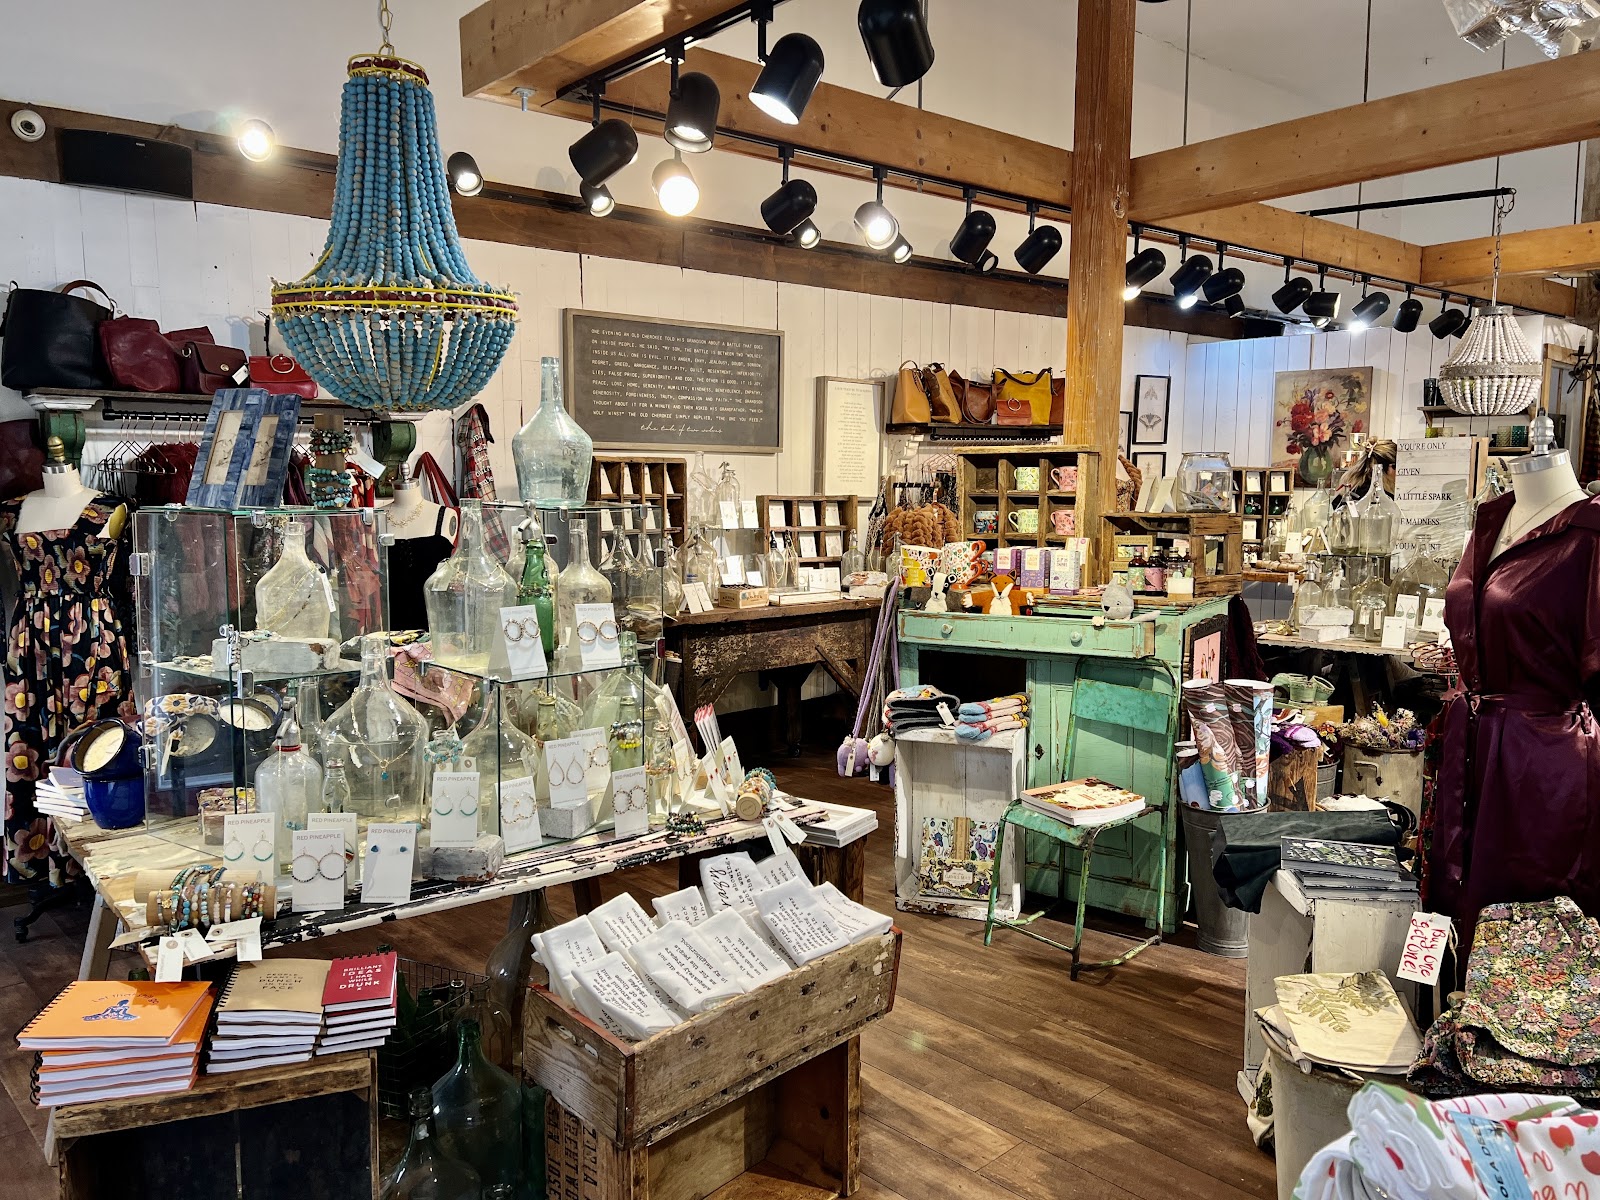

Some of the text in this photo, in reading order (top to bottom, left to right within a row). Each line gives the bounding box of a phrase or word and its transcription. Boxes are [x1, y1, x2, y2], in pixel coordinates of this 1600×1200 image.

[725, 857, 738, 892] showing.
[734, 868, 744, 886] want
[744, 874, 753, 892] that
[710, 867, 732, 907] razy
[691, 906, 700, 922] hug
[779, 902, 806, 936] questionable
[789, 897, 828, 945] everything ever
[770, 917, 802, 955] you drink too
[817, 927, 833, 943] wanted
[822, 921, 838, 940] friend.
[680, 938, 713, 970] neighborhood.
[1402, 919, 1430, 973] get One!
[1419, 929, 1446, 977] Buy One
[658, 952, 675, 971] did not
[665, 947, 711, 990] adequately prepare
[674, 944, 709, 978] for the people
[342, 968, 382, 976] IDEAS
[601, 969, 612, 980] and
[339, 980, 380, 989] DRUNK
[611, 981, 631, 1000] around
[614, 975, 630, 990] those
[631, 1001, 644, 1013] turn
[638, 998, 648, 1008] one
[1490, 1162, 1499, 1171] A
